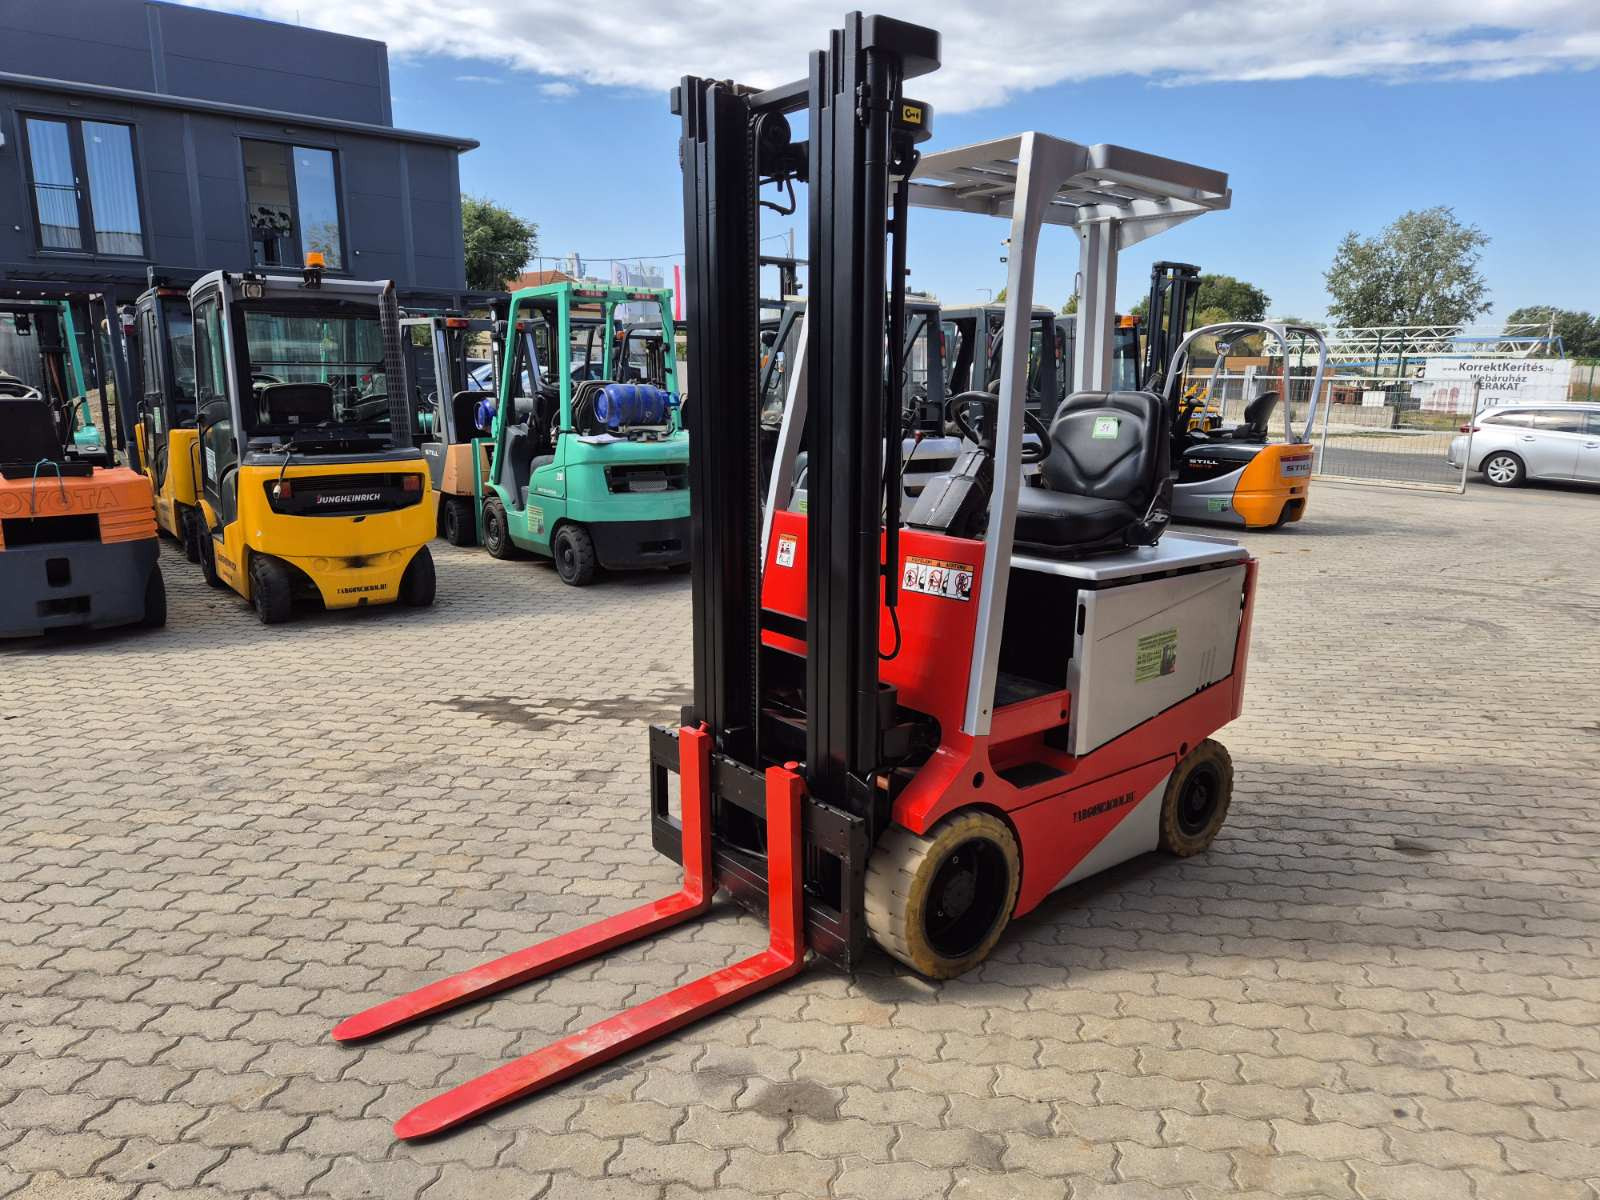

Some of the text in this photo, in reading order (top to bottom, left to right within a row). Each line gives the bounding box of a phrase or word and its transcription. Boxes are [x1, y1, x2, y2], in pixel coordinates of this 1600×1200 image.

[1479, 382, 1520, 391] ERAKAT
[0, 486, 120, 515] OYOTA
[317, 493, 381, 504] JUNGHEINRICH
